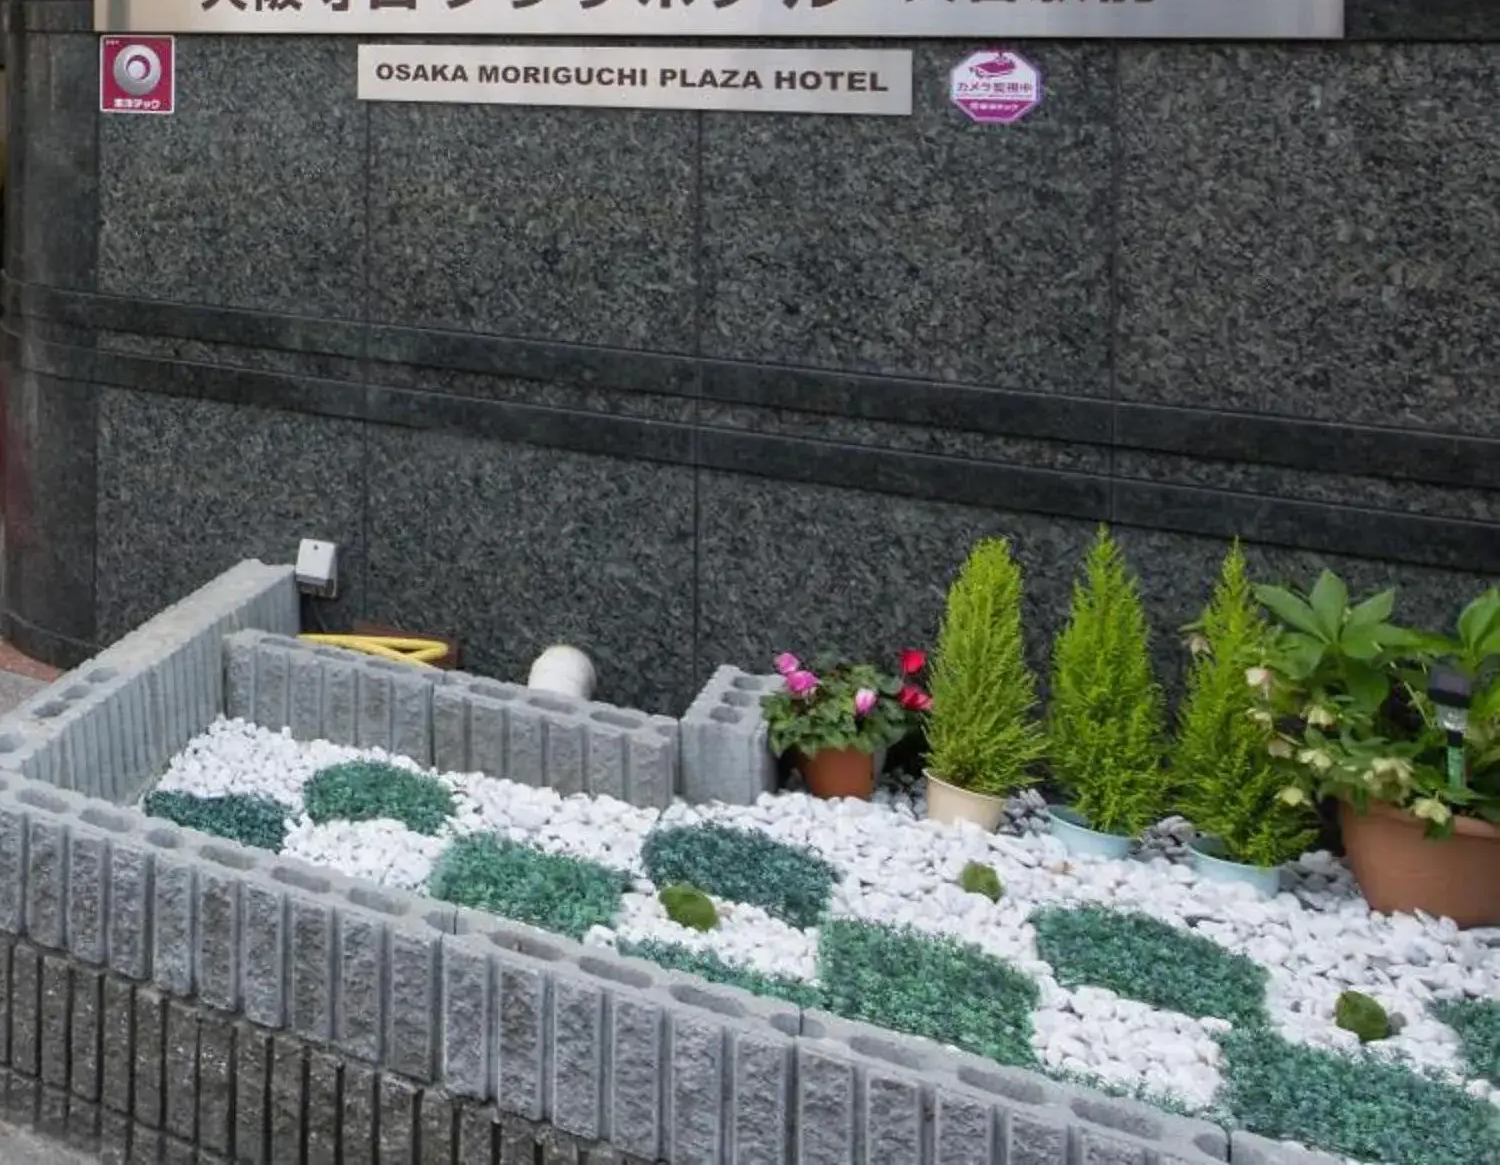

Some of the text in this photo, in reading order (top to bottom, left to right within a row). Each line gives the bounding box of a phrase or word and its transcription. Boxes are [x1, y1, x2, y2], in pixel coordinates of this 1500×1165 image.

[375, 61, 890, 93] OSAKA MORIGUCHI PLAZA HOTEL
